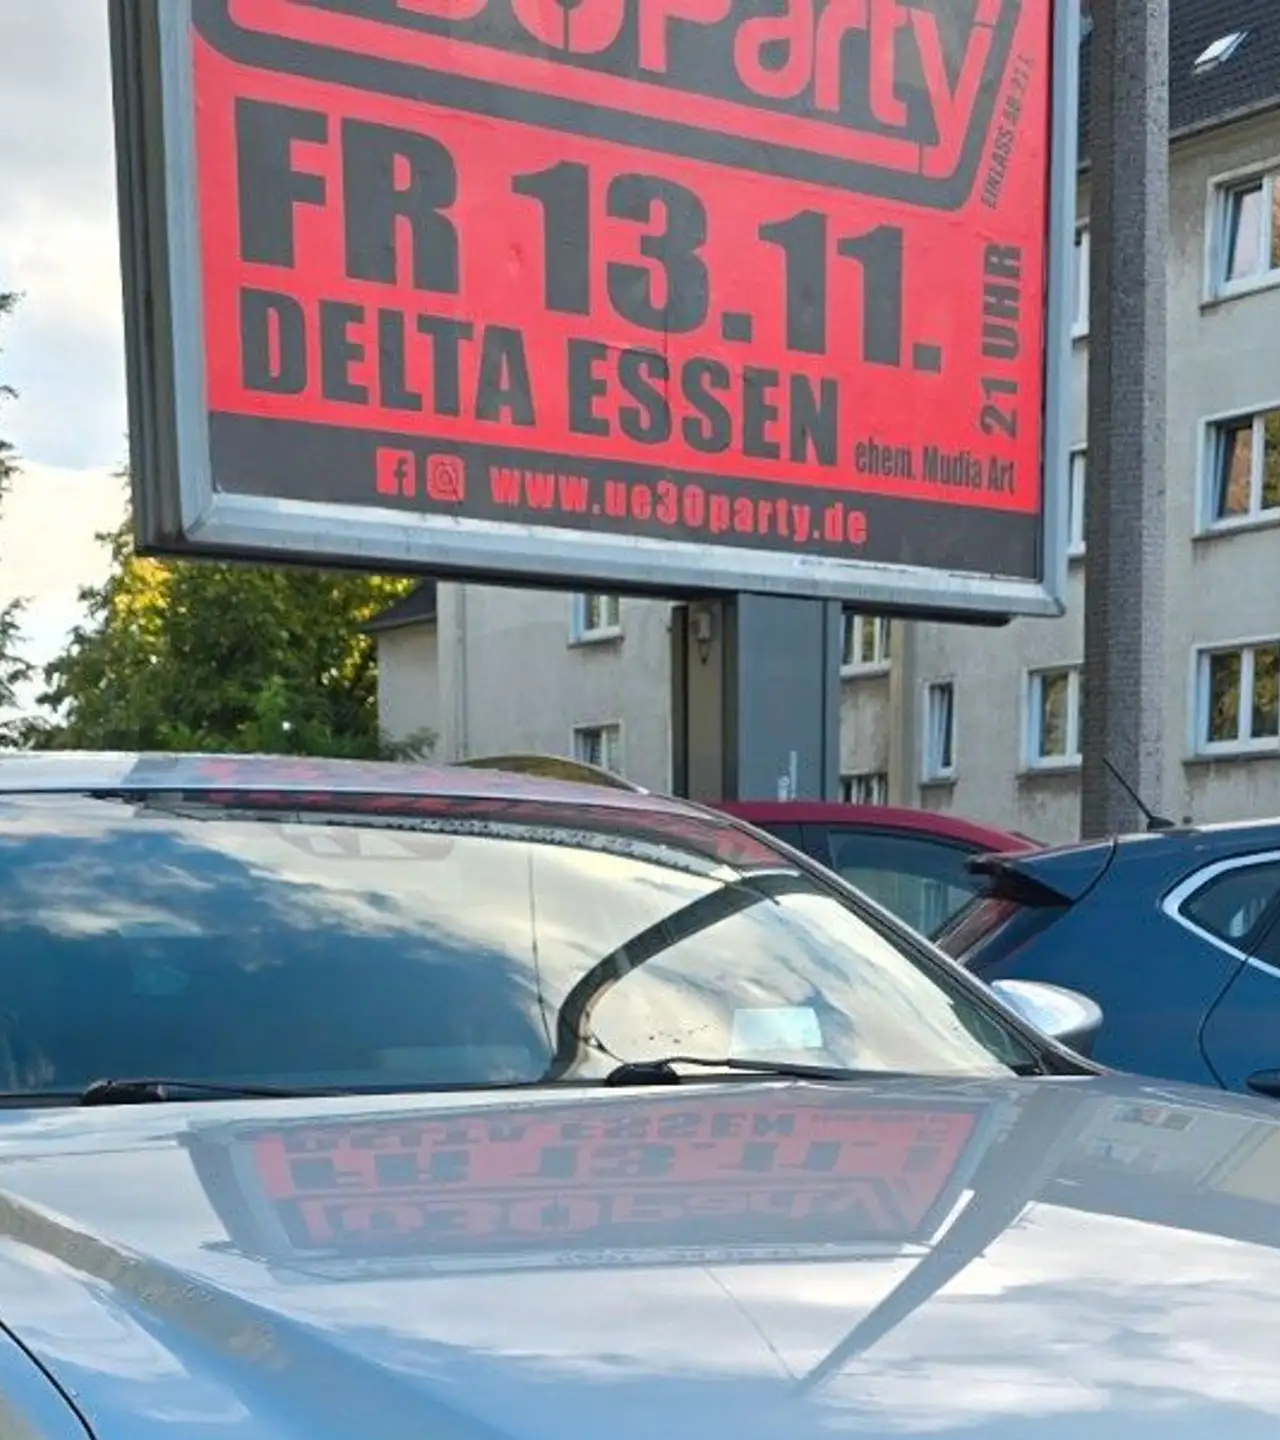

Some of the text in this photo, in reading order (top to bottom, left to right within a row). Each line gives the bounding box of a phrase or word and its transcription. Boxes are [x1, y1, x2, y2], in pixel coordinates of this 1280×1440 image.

[234, 97, 942, 373] FR 13.11.
[239, 286, 838, 466] DELTA ESSEN
[979, 244, 1021, 439] 21 UHR
[490, 465, 868, 545] www.ue30party.de
[854, 440, 1017, 495] ehem. Mudia Art
